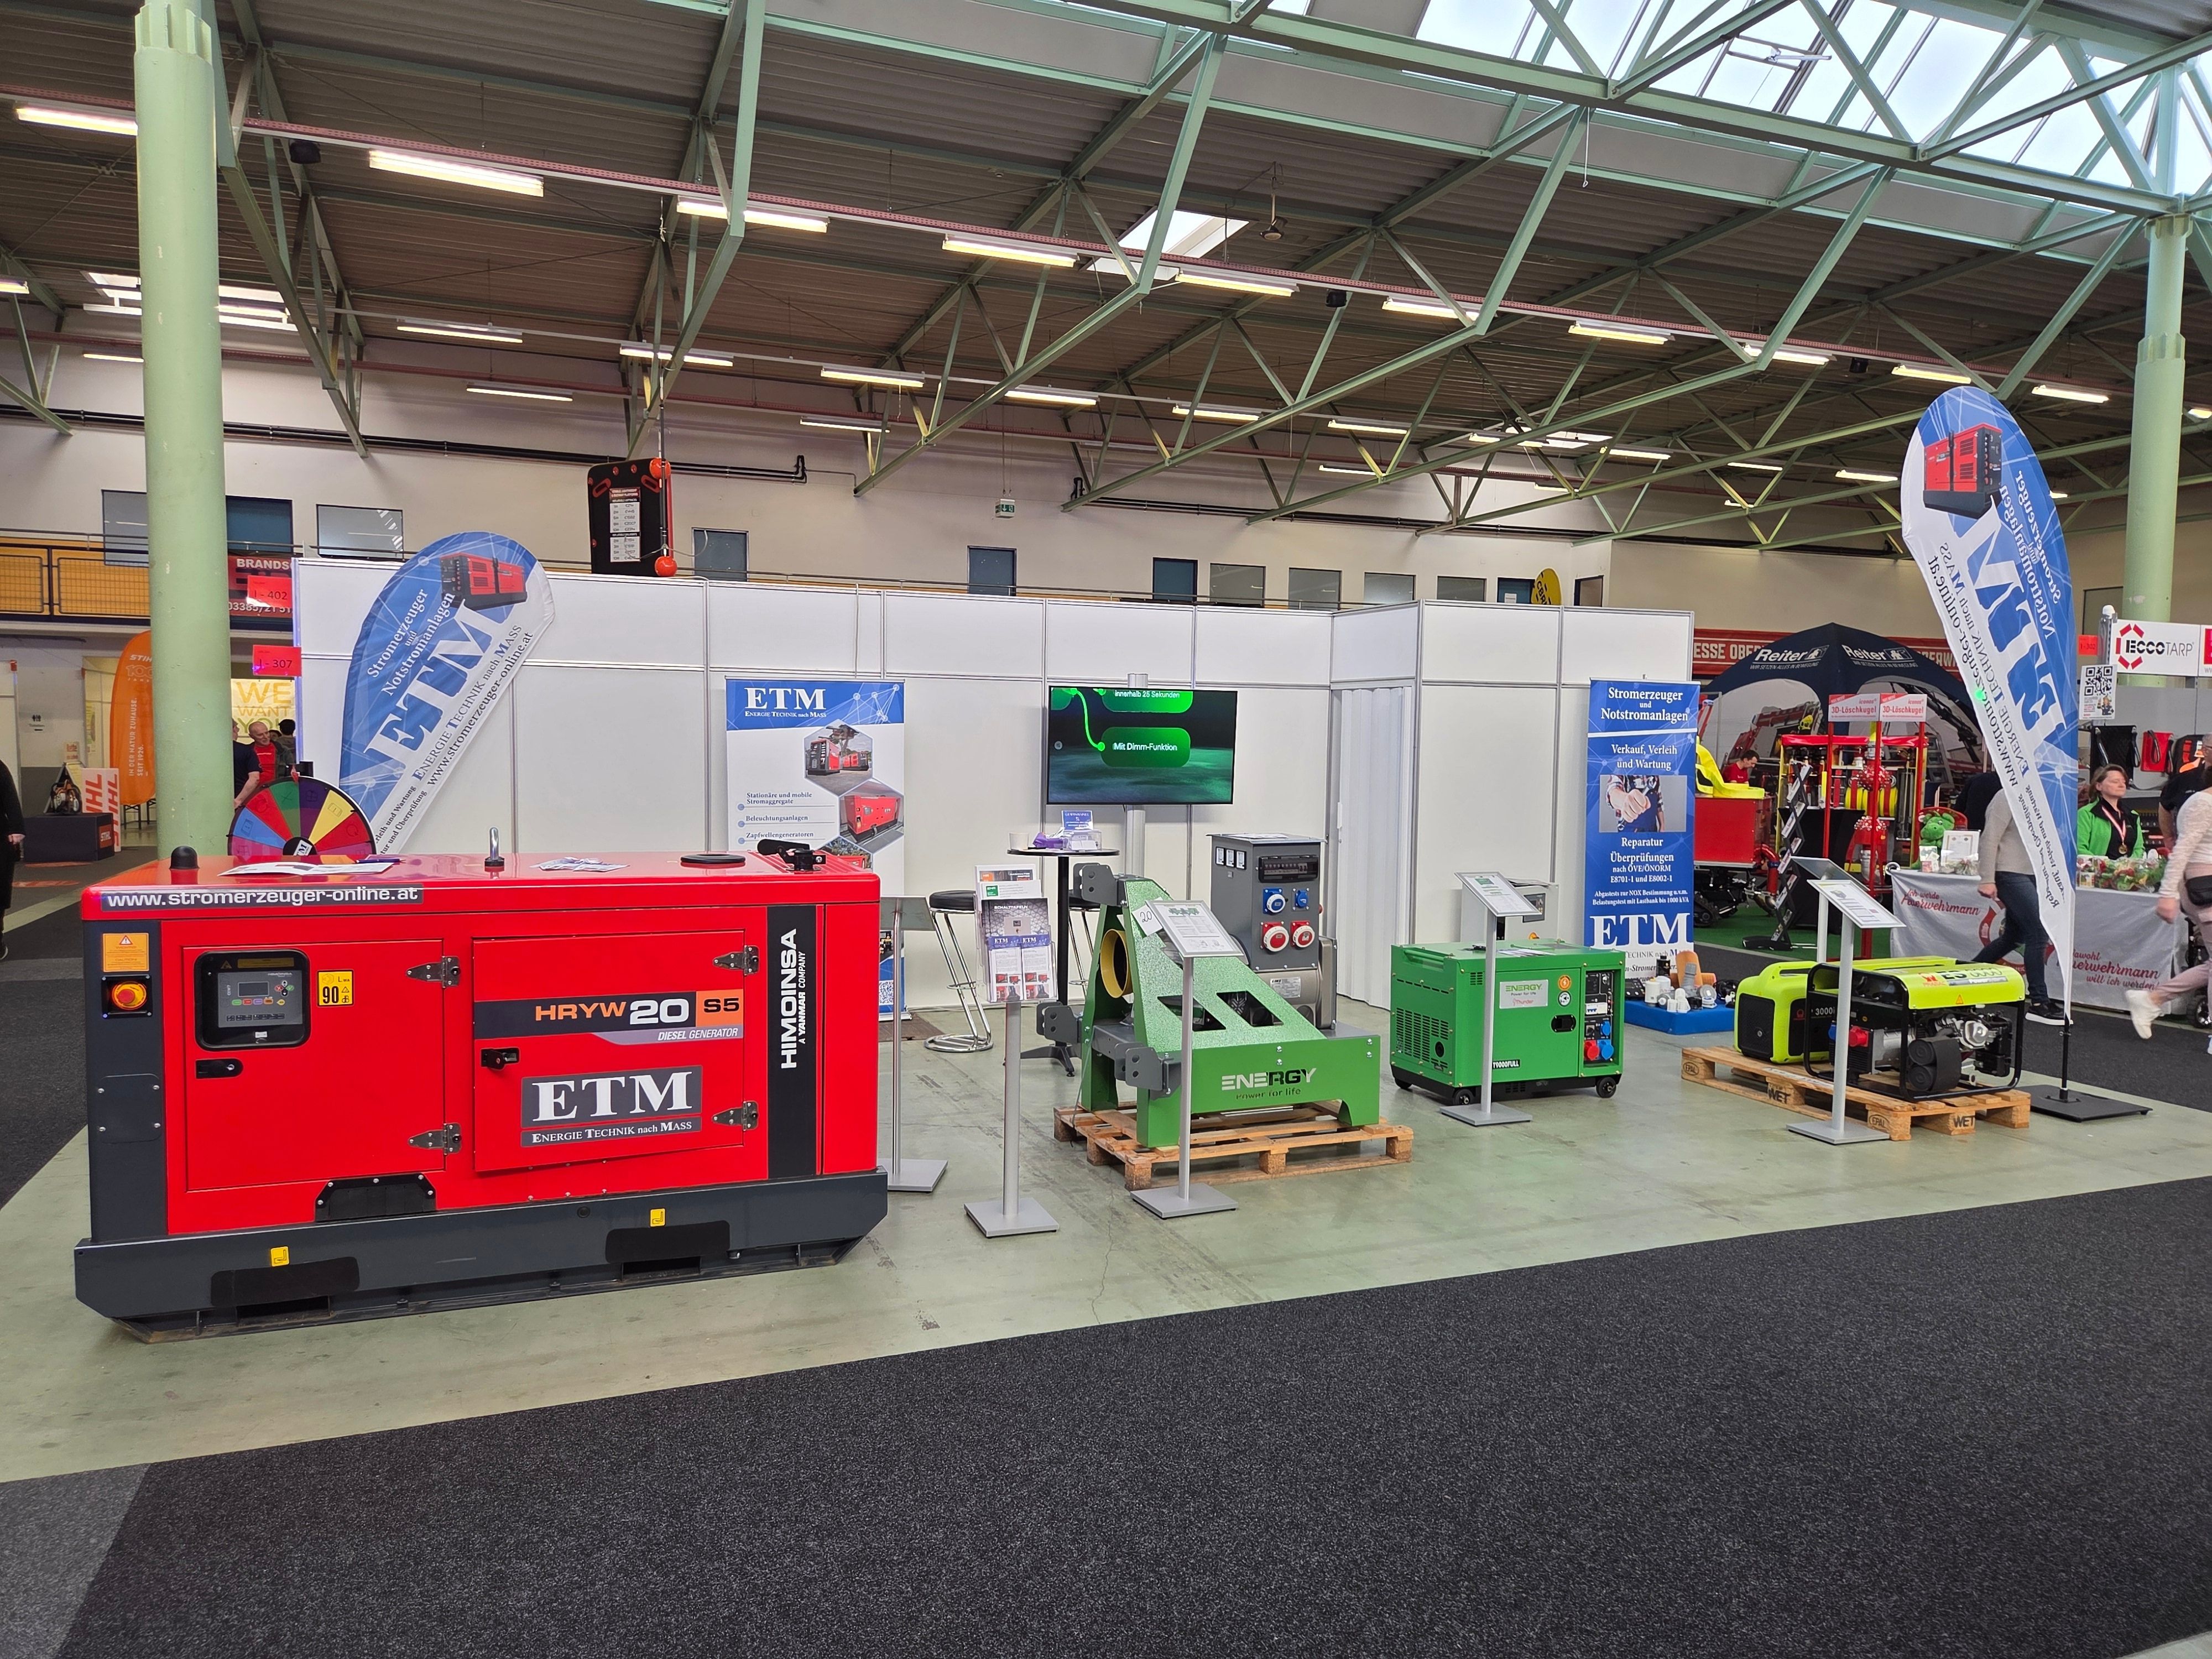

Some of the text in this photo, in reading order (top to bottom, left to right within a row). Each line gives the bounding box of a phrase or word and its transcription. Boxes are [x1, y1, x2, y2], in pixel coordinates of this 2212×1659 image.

[268, 591, 288, 600] 402
[1537, 581, 1547, 604] CBR
[367, 588, 428, 678] Stromerzeuger
[405, 630, 417, 647] und
[381, 592, 456, 696] Notstromanlagen
[1693, 643, 1726, 659] ESSE
[1841, 644, 1887, 660] Reiter
[129, 654, 152, 662] STIH
[1755, 649, 1807, 661] Reiter
[273, 660, 292, 669] 307
[363, 598, 503, 764] ETM
[236, 682, 291, 703] WE
[744, 688, 826, 709] ETM
[1608, 687, 1683, 703] Stromerzeuger
[412, 625, 522, 781] ENERGIE TECHNIK nach MASS
[427, 632, 534, 786] www.stromerzeuger-online.at
[1832, 706, 1876, 714] 3D-Löschkugel
[1882, 706, 1923, 714] 3D-Löschkugel
[238, 706, 291, 717] WANT
[1601, 708, 1688, 724] Notstromanlagen
[1126, 743, 1177, 751] Dimm-Funktion
[1611, 744, 1677, 755] Verkauf, Verleih
[1617, 759, 1671, 771] und Wartung
[386, 812, 397, 826] und
[394, 786, 416, 811] Wartung
[388, 790, 427, 844] und Überprüfung
[1621, 838, 1663, 849] Reparatur
[1610, 851, 1674, 864] Überprüfungen
[1627, 864, 1671, 873] ÖVE/ÖNORM
[107, 886, 418, 906] www.stromerzeuger-online.at
[1140, 911, 1152, 922] 20
[1589, 912, 1693, 947] ETM
[2107, 976, 2120, 986] ich
[322, 985, 339, 1004] 90
[781, 928, 797, 1068] HIMOINSA
[535, 998, 739, 1025] HRYW 20 S5
[658, 1027, 738, 1041] DIESEL GENERATOR
[1222, 1067, 1317, 1091] ENERGY
[531, 1071, 692, 1121] ETM
[1236, 1092, 1265, 1100] Power
[1286, 1087, 1301, 1096] life
[1953, 1115, 1975, 1128] WET
[532, 1121, 692, 1143] ENERGIE TECHNIK nach MASS
